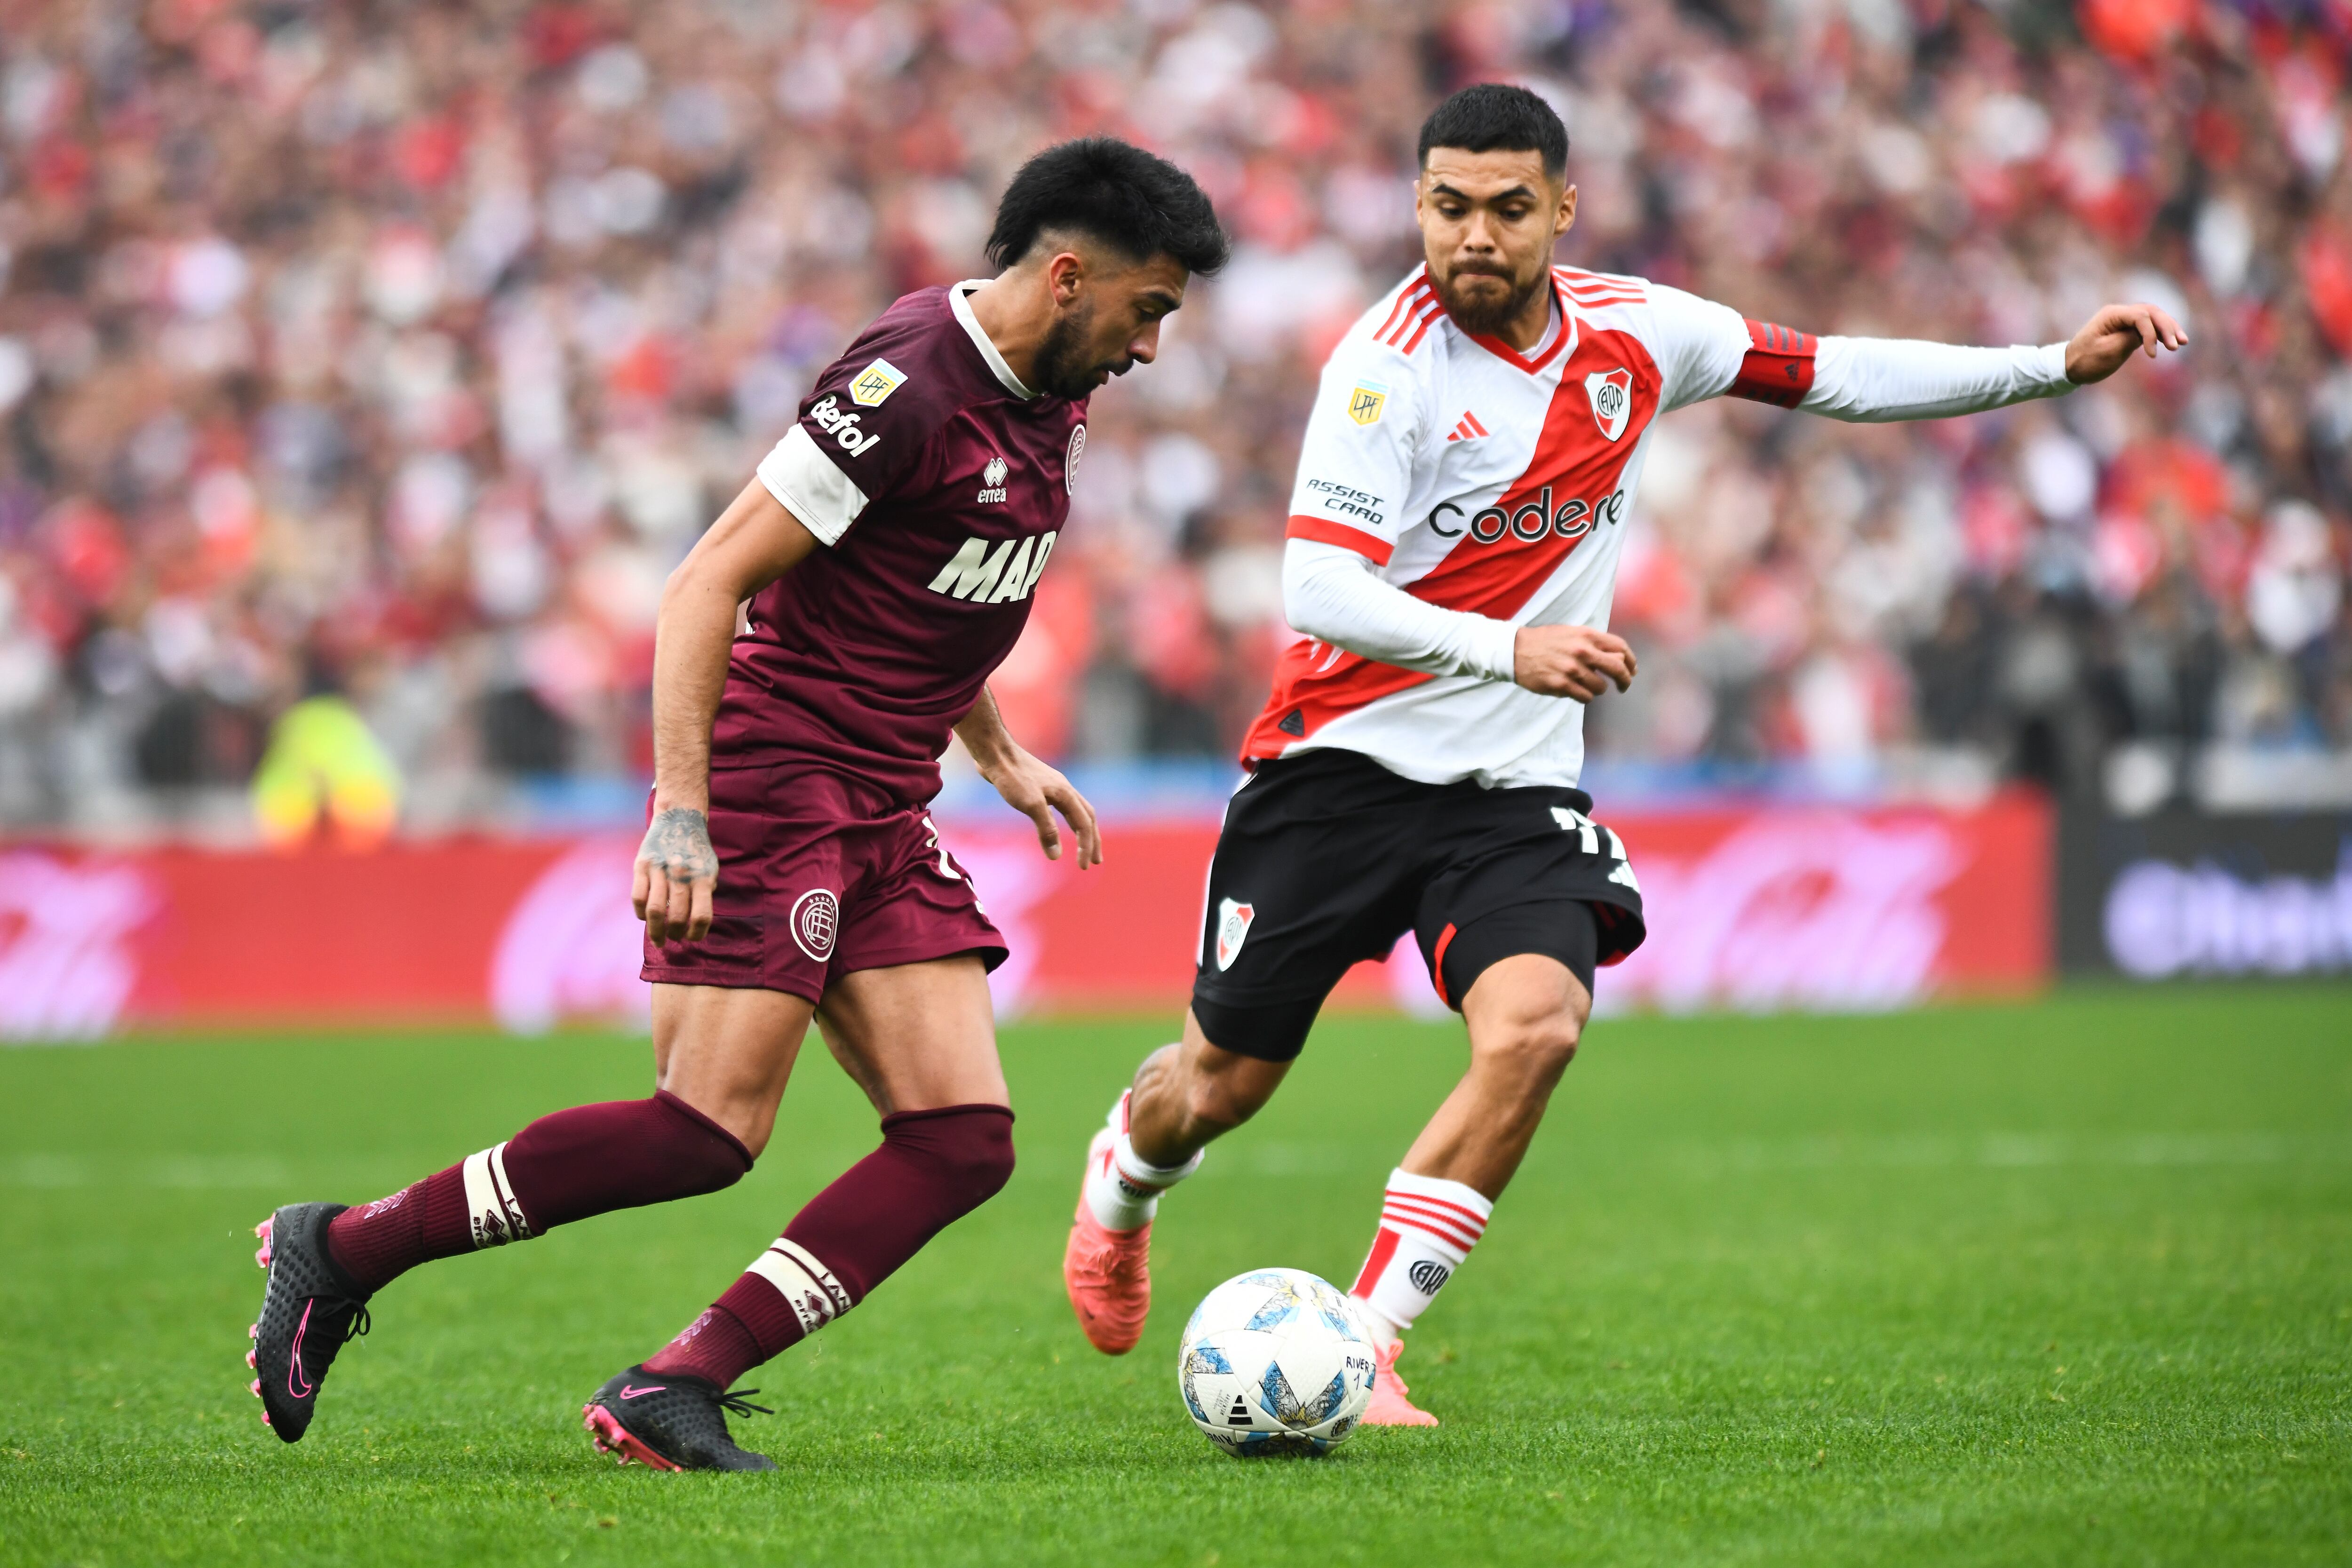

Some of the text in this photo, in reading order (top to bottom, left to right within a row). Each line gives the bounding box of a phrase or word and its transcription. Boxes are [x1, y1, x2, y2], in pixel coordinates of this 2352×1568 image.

[810, 393, 881, 458] Befol
[1306, 478, 1385, 508] ASSIST
[1324, 498, 1384, 525] CARD
[927, 530, 1057, 604] MAP
[1346, 1356, 1369, 1375] RIVER
[1202, 1429, 1235, 1446] RIVE
